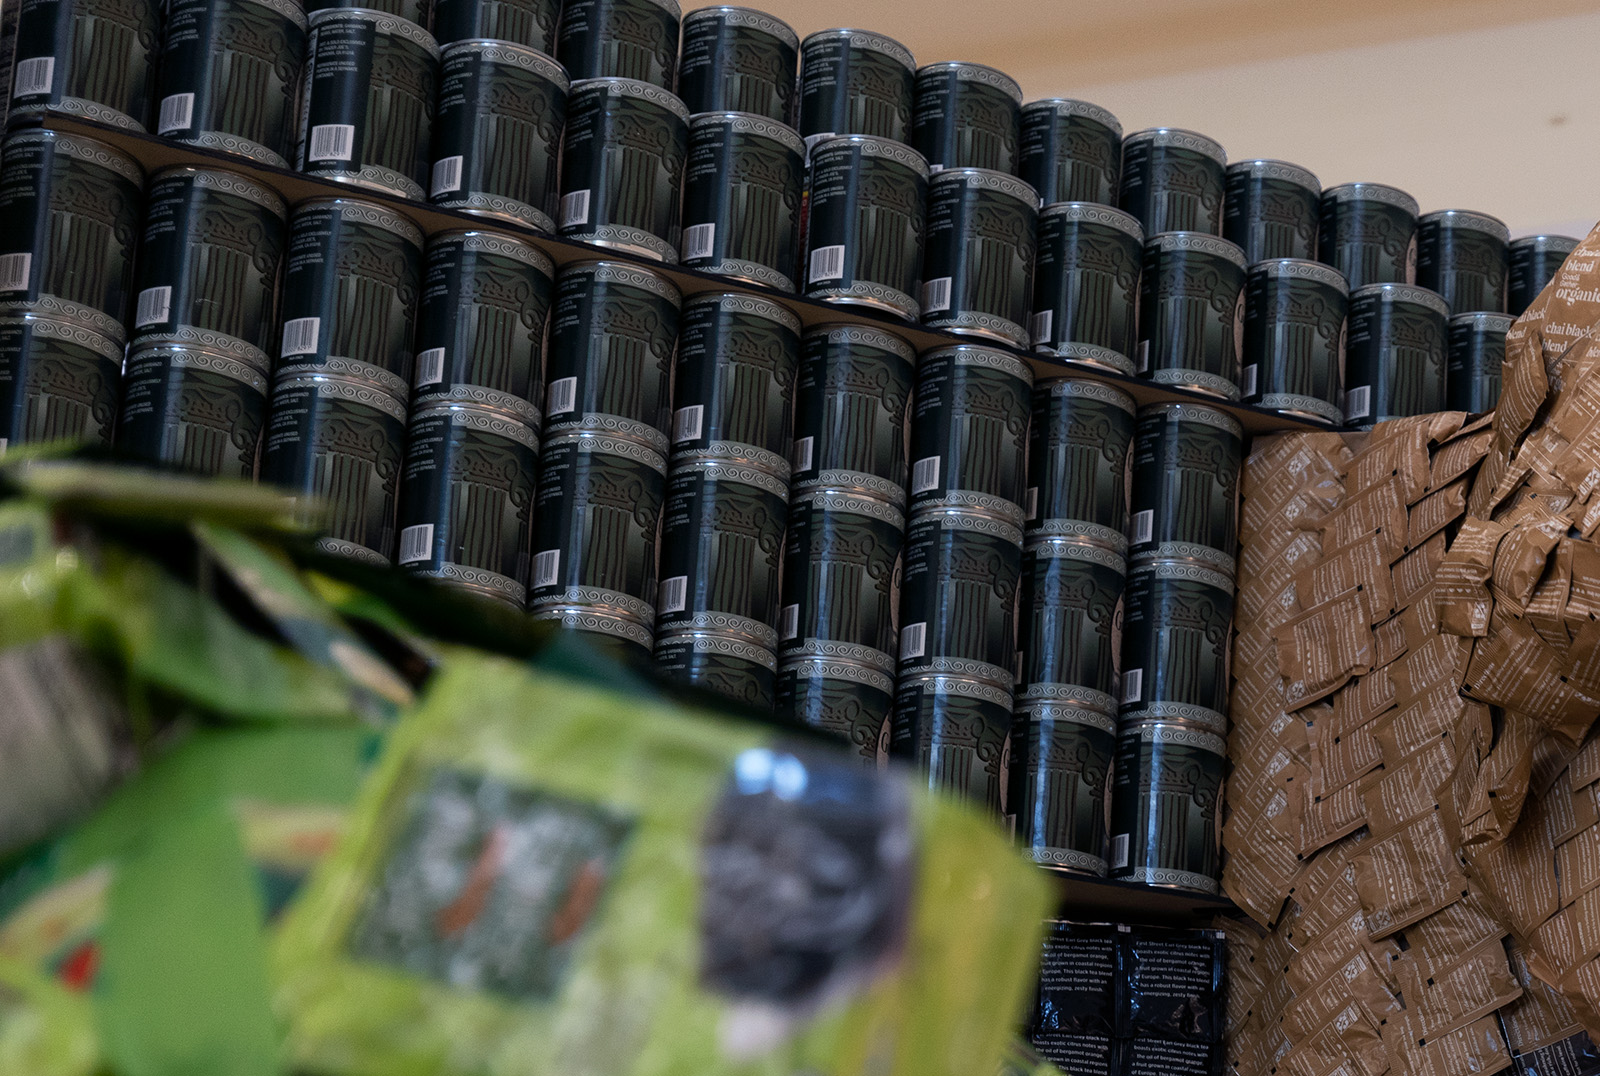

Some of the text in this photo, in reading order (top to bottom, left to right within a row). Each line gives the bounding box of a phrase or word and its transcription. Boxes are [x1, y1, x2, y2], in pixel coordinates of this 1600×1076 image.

[1566, 259, 1595, 272] blend
[1526, 308, 1545, 321] black
[1546, 321, 1592, 339] chai black
[1541, 339, 1568, 352] blend
